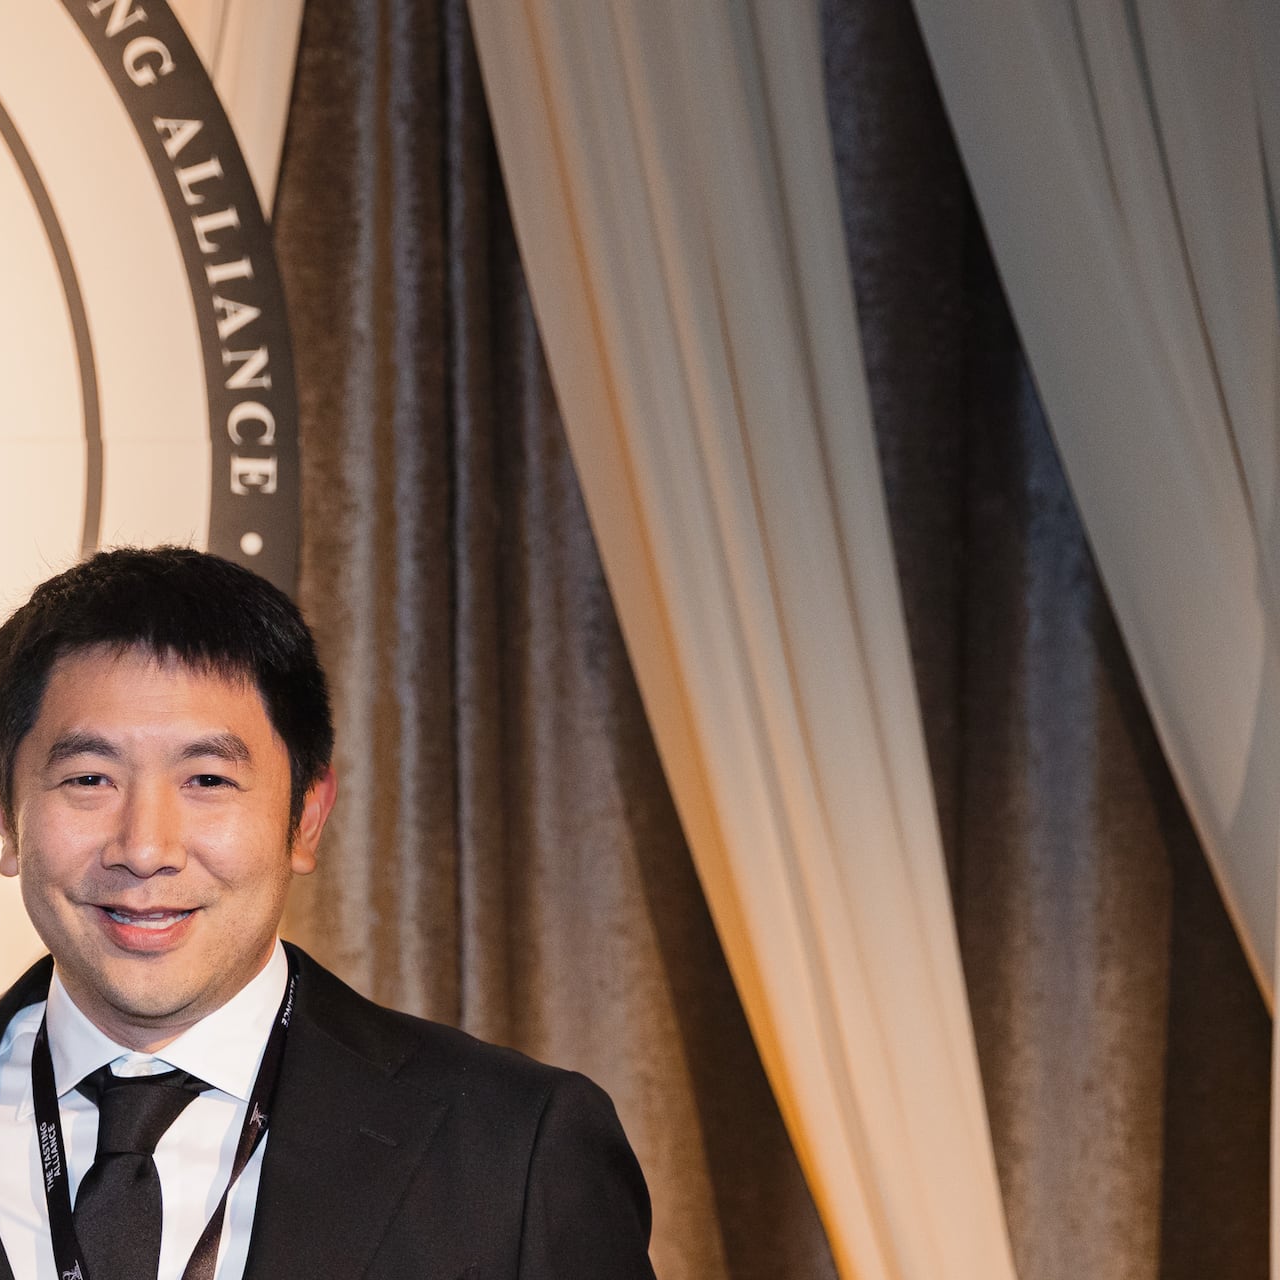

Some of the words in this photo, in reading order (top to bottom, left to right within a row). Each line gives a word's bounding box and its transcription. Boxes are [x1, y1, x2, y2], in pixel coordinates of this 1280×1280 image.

[153, 116, 277, 495] ALLIANCE
[40, 1122, 51, 1169] TASTING
[48, 1123, 61, 1176] ALLIANCE
